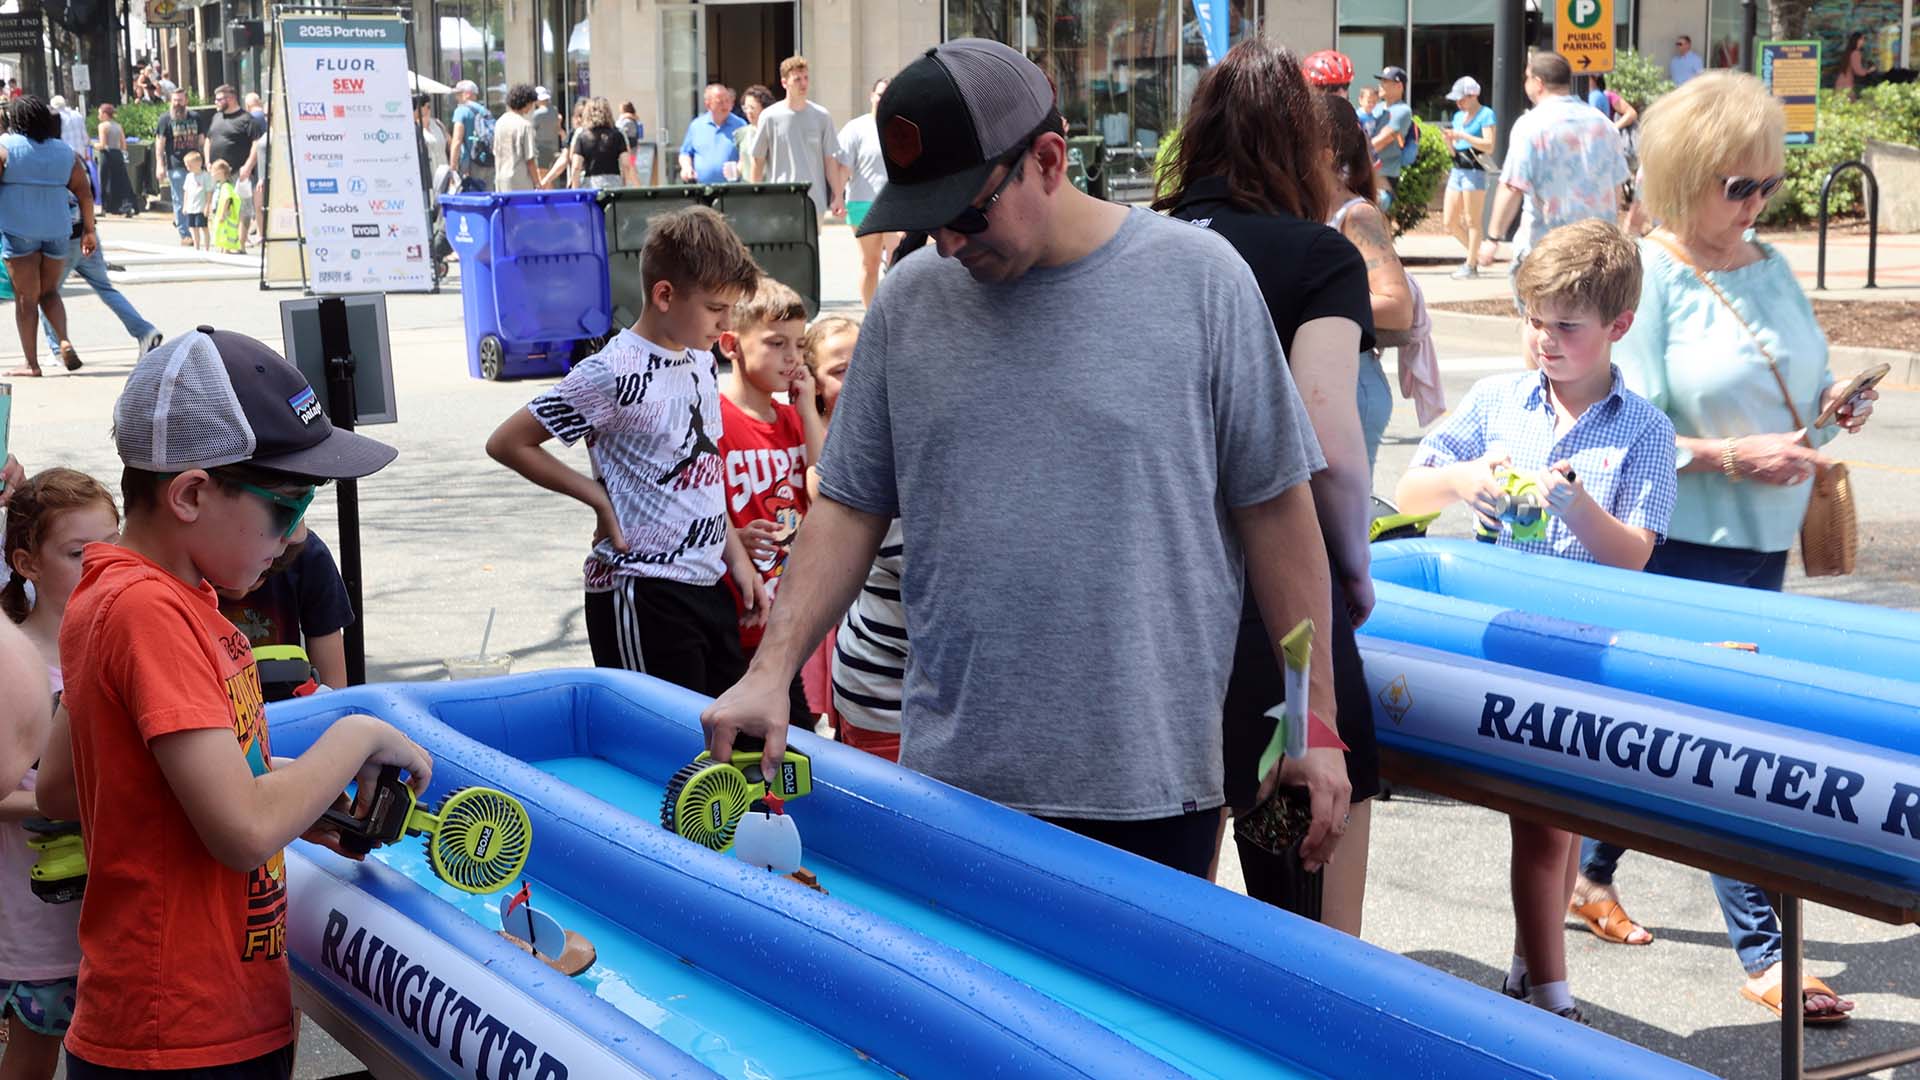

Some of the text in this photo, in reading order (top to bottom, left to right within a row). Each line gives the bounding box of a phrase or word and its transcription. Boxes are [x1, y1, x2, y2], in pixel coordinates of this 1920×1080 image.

[299, 26, 386, 37] 2025 Partners
[1567, 32, 1602, 41] PUBLIC
[1563, 42, 1606, 50] PARKING
[316, 59, 375, 71] FLUOR
[333, 78, 364, 90] SEW
[300, 103, 323, 115] FOX
[306, 132, 343, 141] verizon
[320, 203, 359, 213] Jacobs
[354, 226, 379, 236] RYOBI
[1477, 692, 1865, 824] RAINGUTTER
[783, 764, 796, 793] RYOBI
[713, 803, 723, 828] RYOBI
[476, 827, 493, 857] RYOBI
